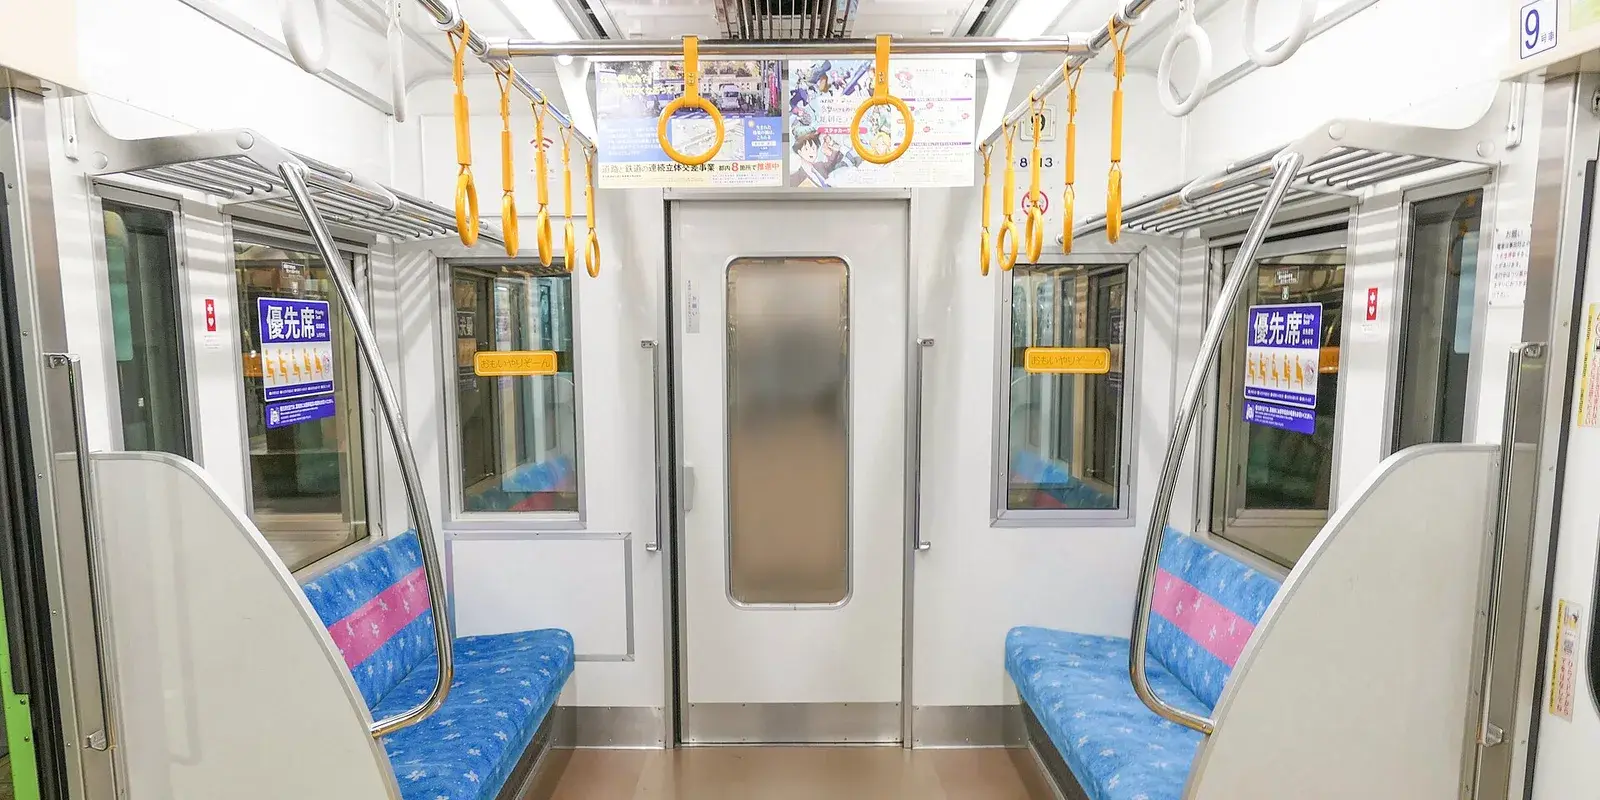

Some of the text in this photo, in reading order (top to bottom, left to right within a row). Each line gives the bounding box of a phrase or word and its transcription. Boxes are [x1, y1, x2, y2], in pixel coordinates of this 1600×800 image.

[602, 163, 715, 173] 道路と鉄道の連続立体交差事業
[266, 305, 315, 340] 優先席
[1254, 311, 1302, 345] 優先席
[480, 358, 551, 369] おもいやりぞーん
[1031, 355, 1104, 366] おもいやりぞーん
